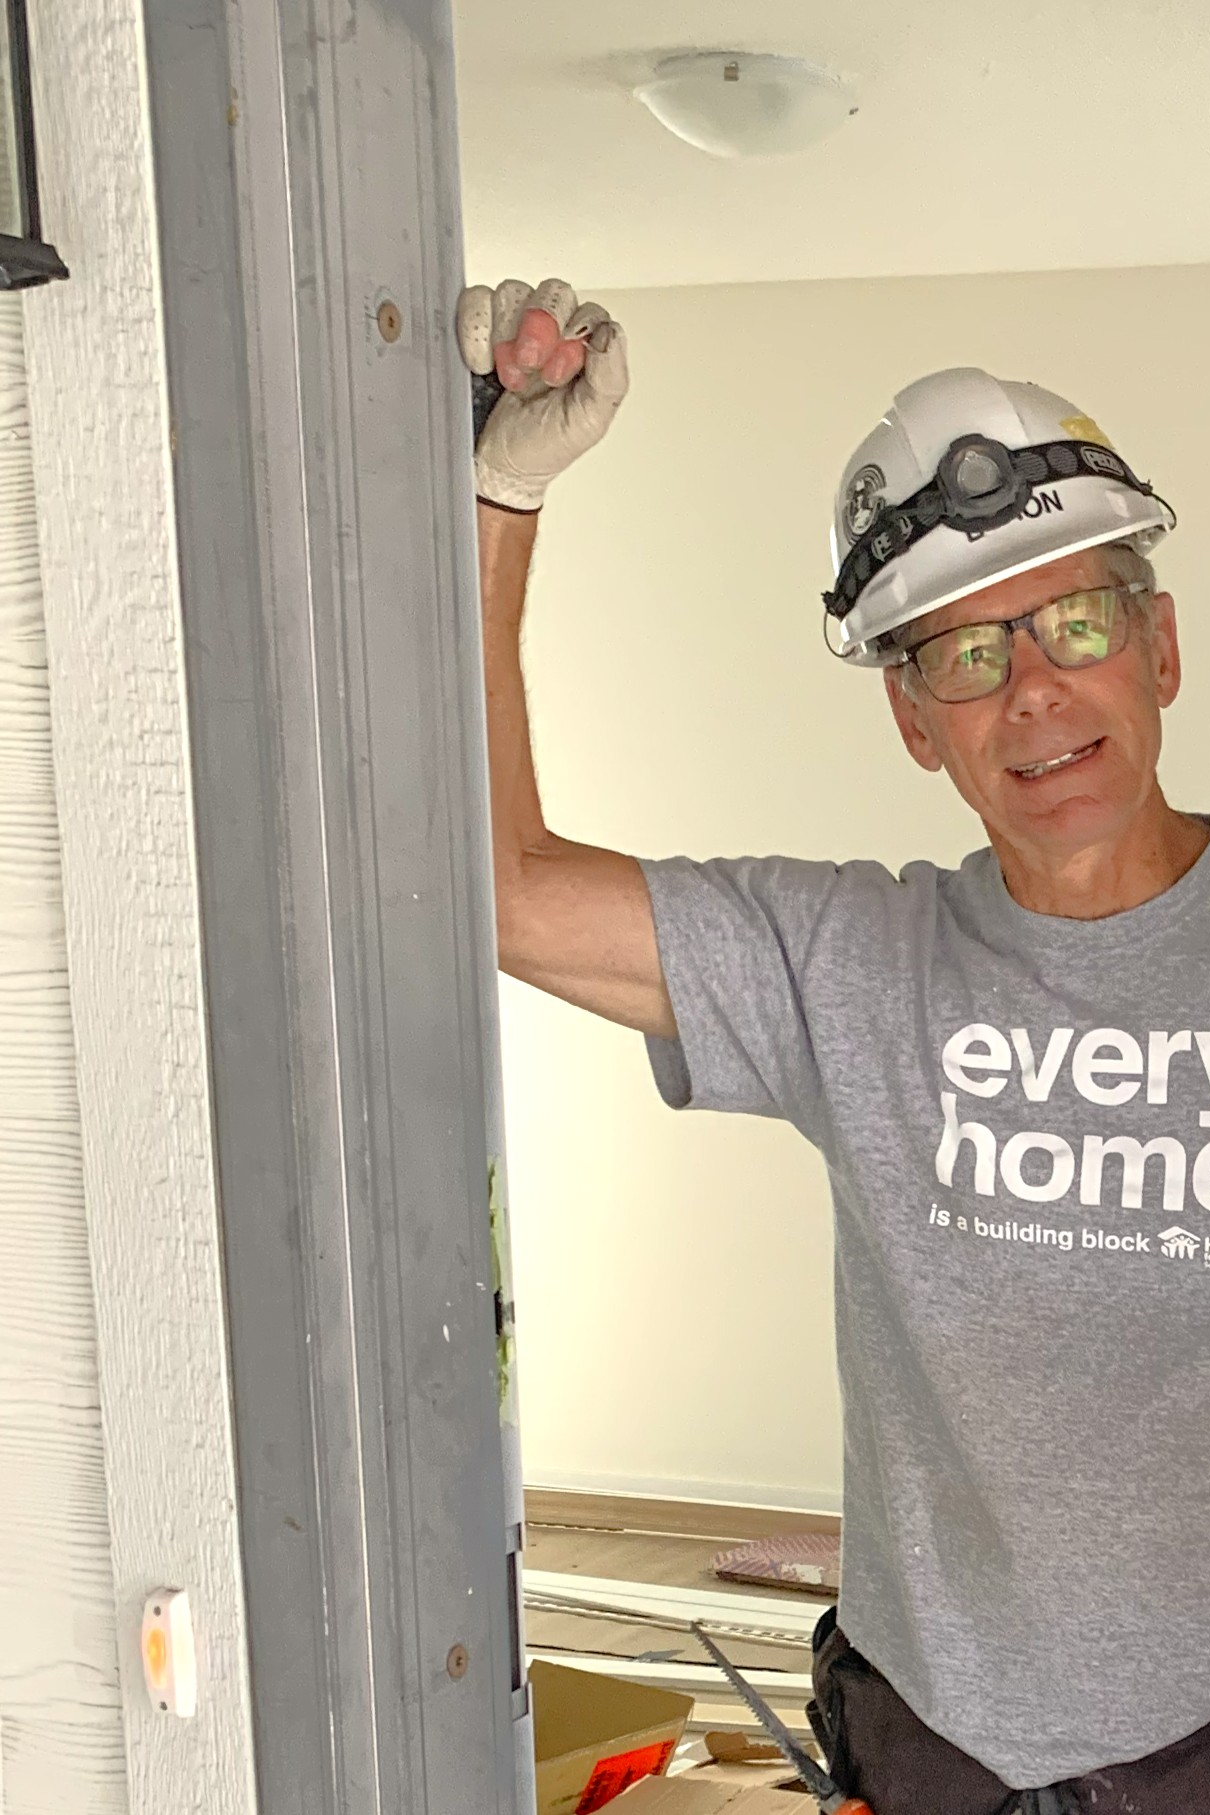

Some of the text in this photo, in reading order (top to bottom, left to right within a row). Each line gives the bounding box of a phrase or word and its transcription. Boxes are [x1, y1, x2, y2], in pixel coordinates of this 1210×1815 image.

[929, 1203, 1151, 1253] is a building block
